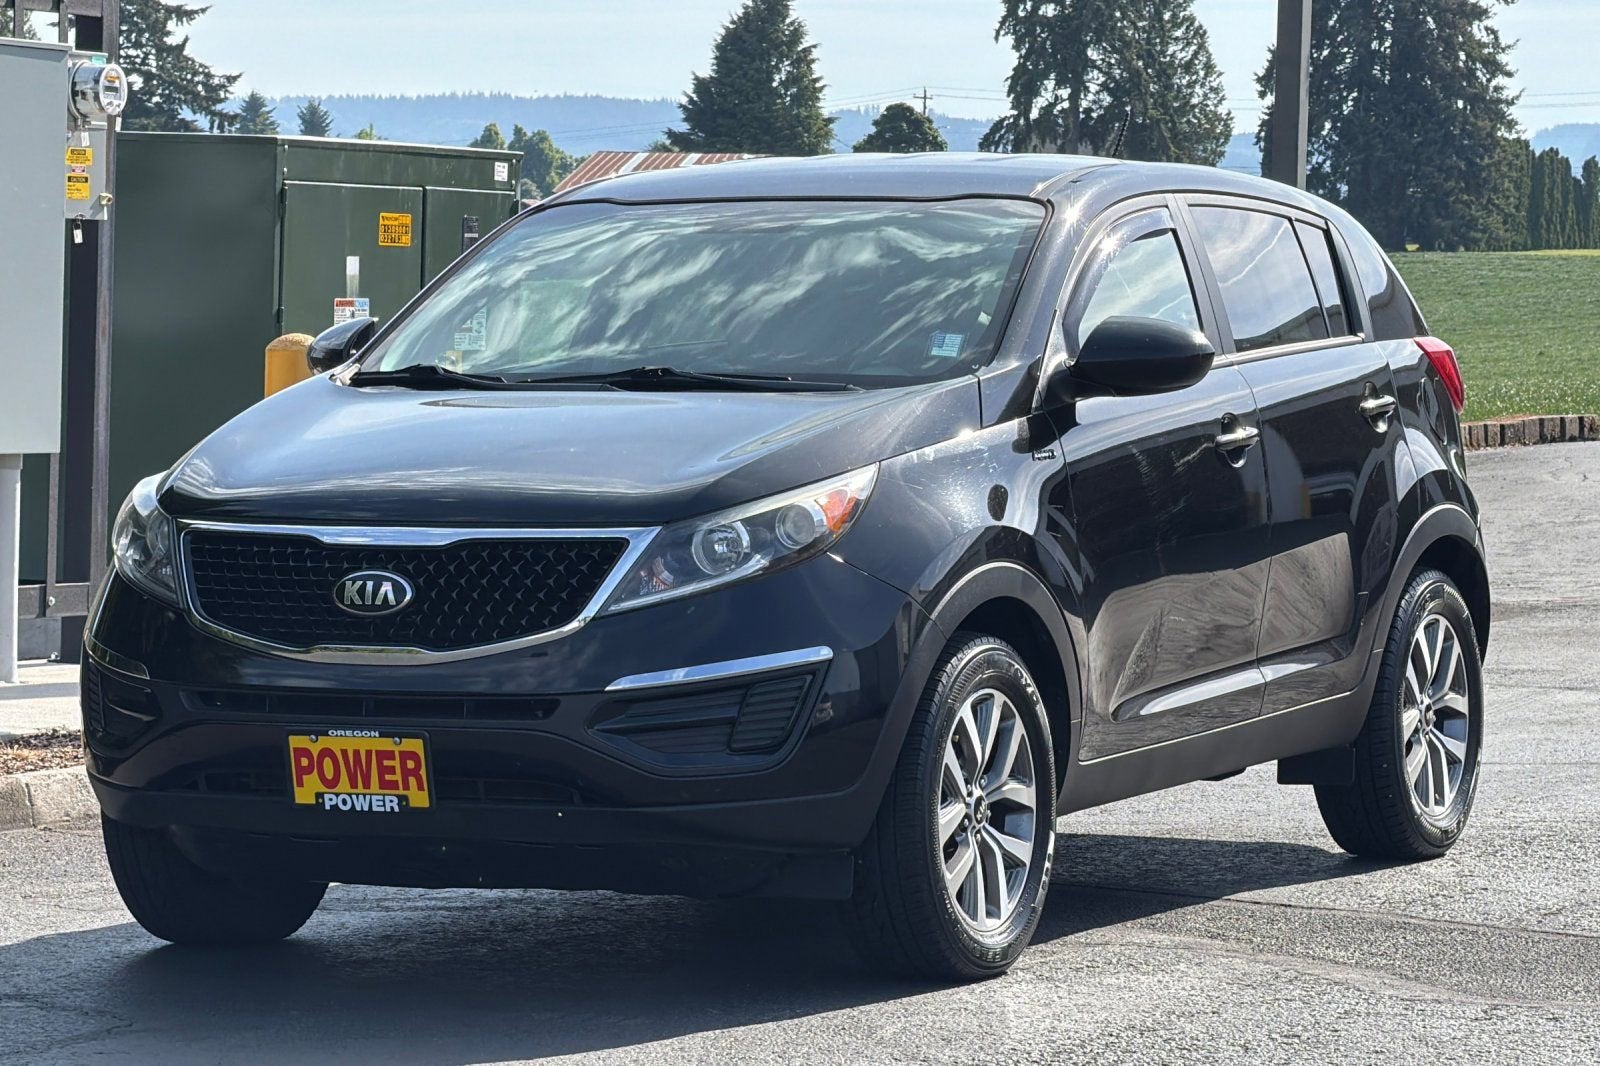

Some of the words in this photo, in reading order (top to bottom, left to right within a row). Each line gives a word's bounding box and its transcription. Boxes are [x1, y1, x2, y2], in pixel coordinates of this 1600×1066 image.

[344, 581, 396, 605] KIA
[328, 729, 380, 738] OREGON
[292, 747, 425, 792] POWER
[323, 793, 400, 813] POWER
